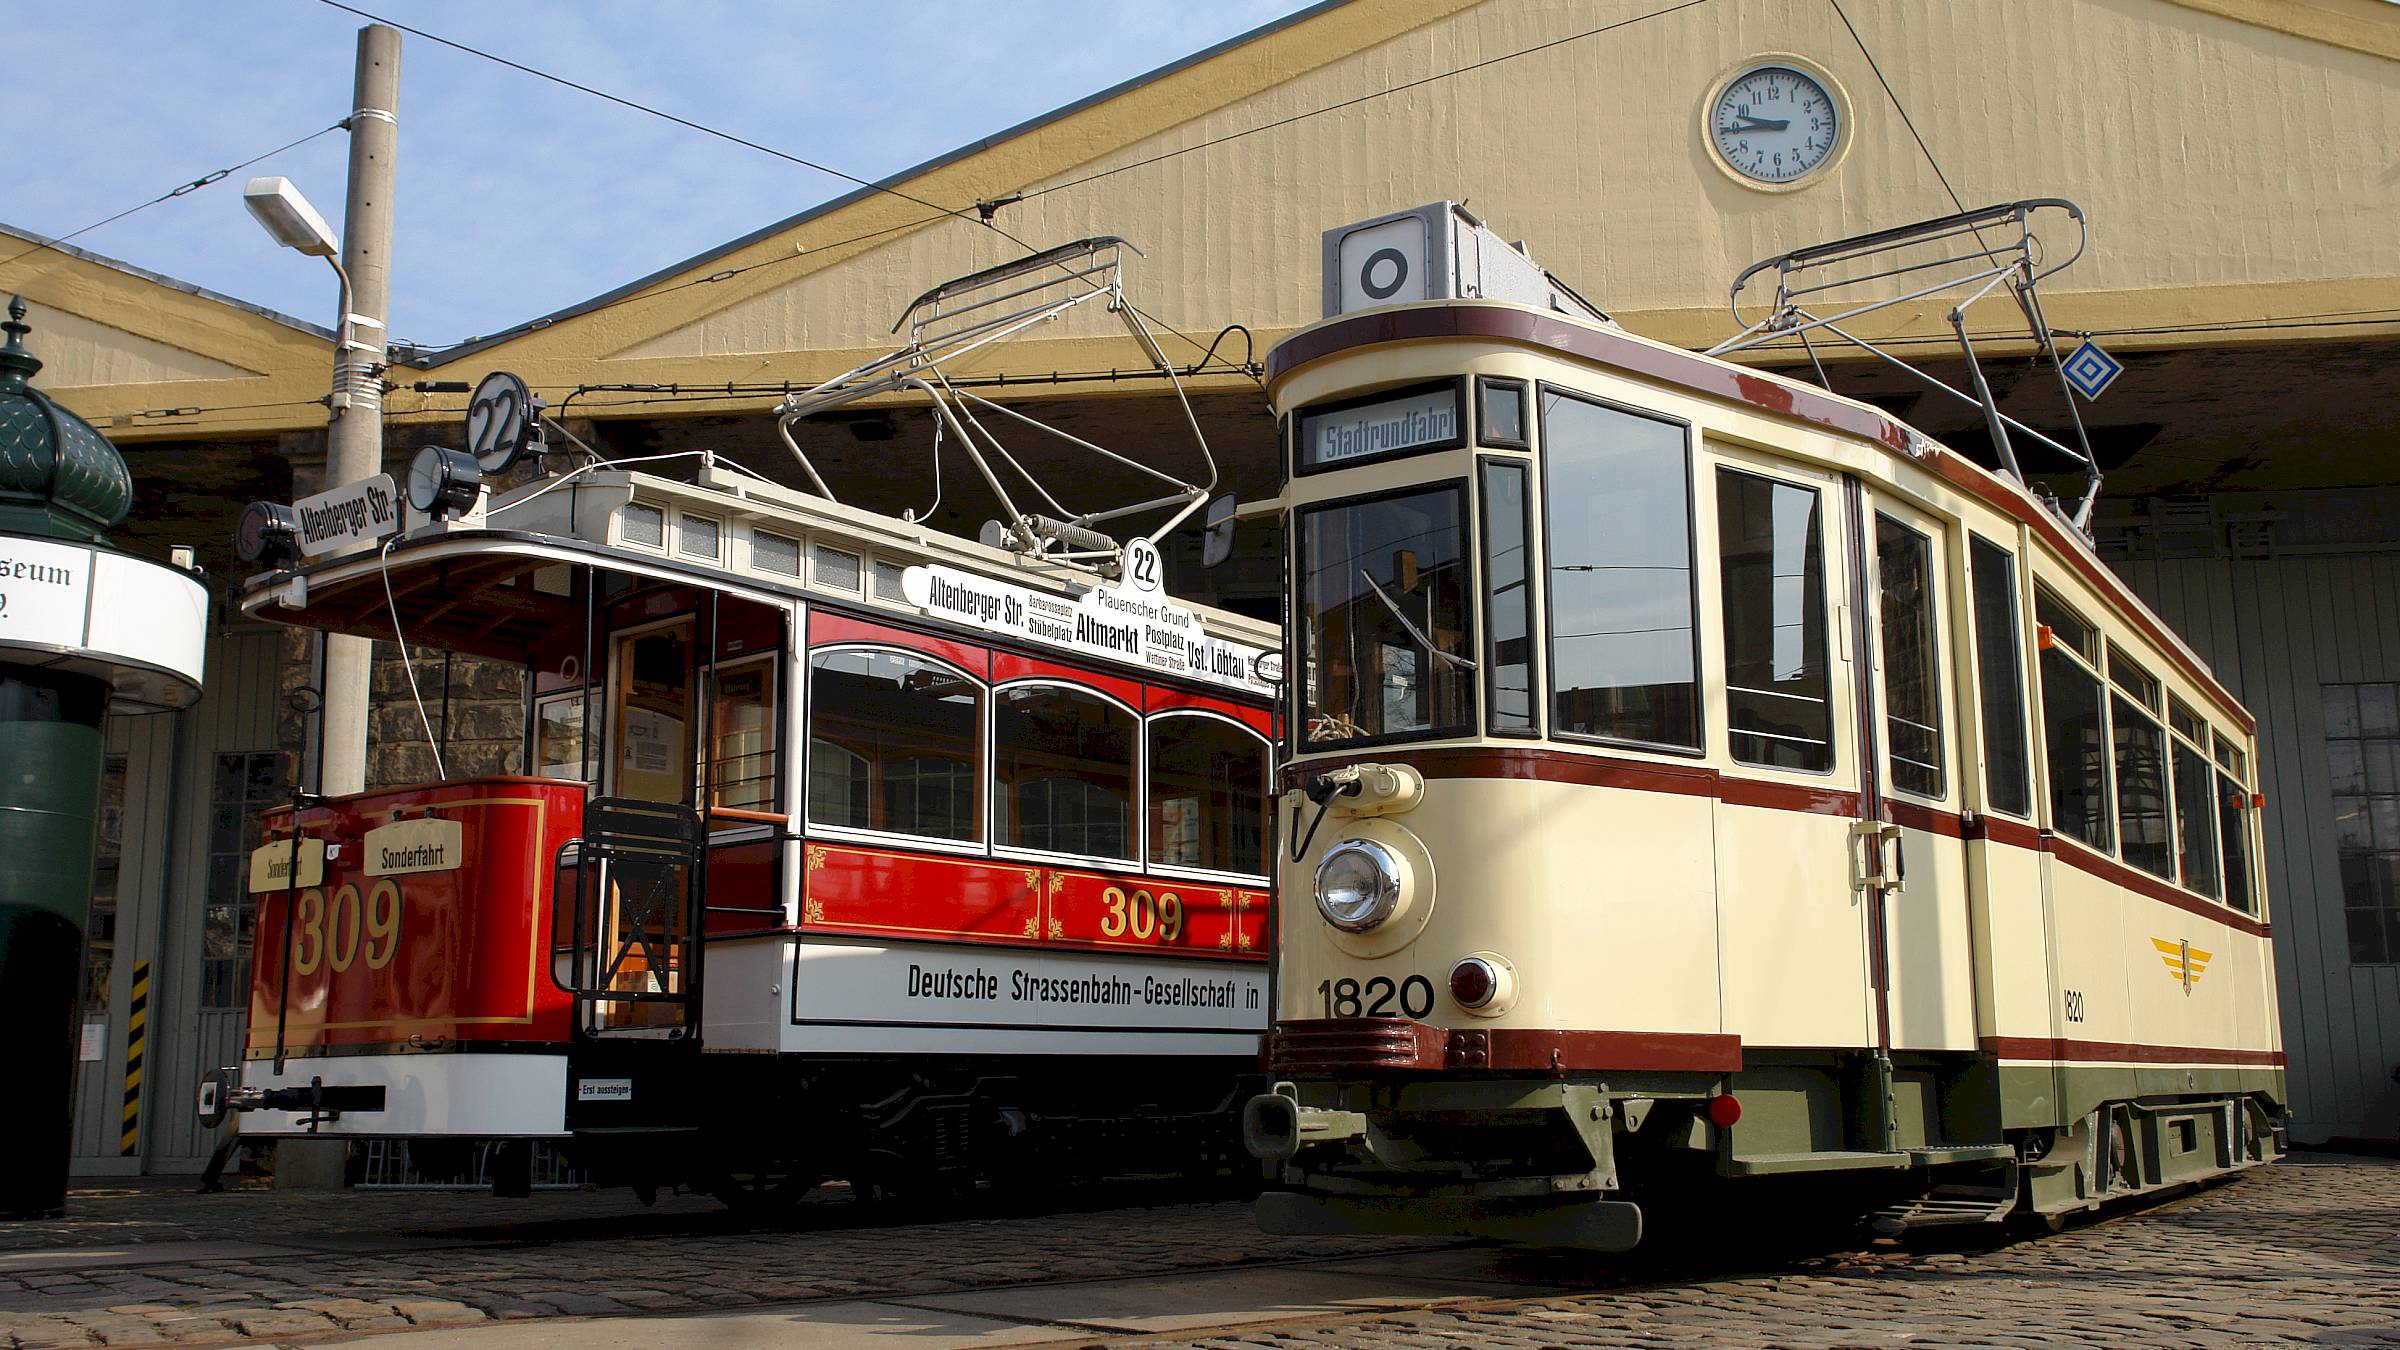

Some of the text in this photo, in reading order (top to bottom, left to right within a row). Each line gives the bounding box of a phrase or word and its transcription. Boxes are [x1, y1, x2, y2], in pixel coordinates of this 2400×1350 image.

[1752, 91, 1762, 105] 11
[1767, 86, 1780, 101] 12
[1737, 103, 1750, 118] 10
[1803, 100, 1812, 115] 2
[1811, 117, 1820, 132] 3
[1739, 139, 1749, 154] 8
[1791, 148, 1801, 162] 5
[1804, 136, 1814, 150] 4
[1756, 150, 1765, 164] 7
[1773, 152, 1782, 166] 6
[472, 388, 518, 459] 22
[1326, 406, 1456, 458] Stadtrundfahrt
[299, 486, 395, 545] Altenberger Str.
[1134, 547, 1155, 583] 22
[929, 575, 1024, 627] Altenberger Str.
[1098, 588, 1189, 629] Plauenscher Grund
[1028, 618, 1073, 643] Stübelplatz
[1076, 613, 1139, 655] Altmarkt
[1145, 624, 1185, 651] Postplatz
[1187, 640, 1208, 672] Vst.
[1211, 646, 1245, 680] Löbtau
[381, 843, 445, 870] Sonderfahrt
[294, 878, 402, 976] 309
[1101, 886, 1184, 941] 309
[908, 964, 1259, 1009] Deutsche Strassenbahn-Gesellschaft in
[1317, 974, 1435, 1020] 1820
[2064, 989, 2084, 1023] 1820
[582, 1085, 629, 1096] Erst aussteigen
